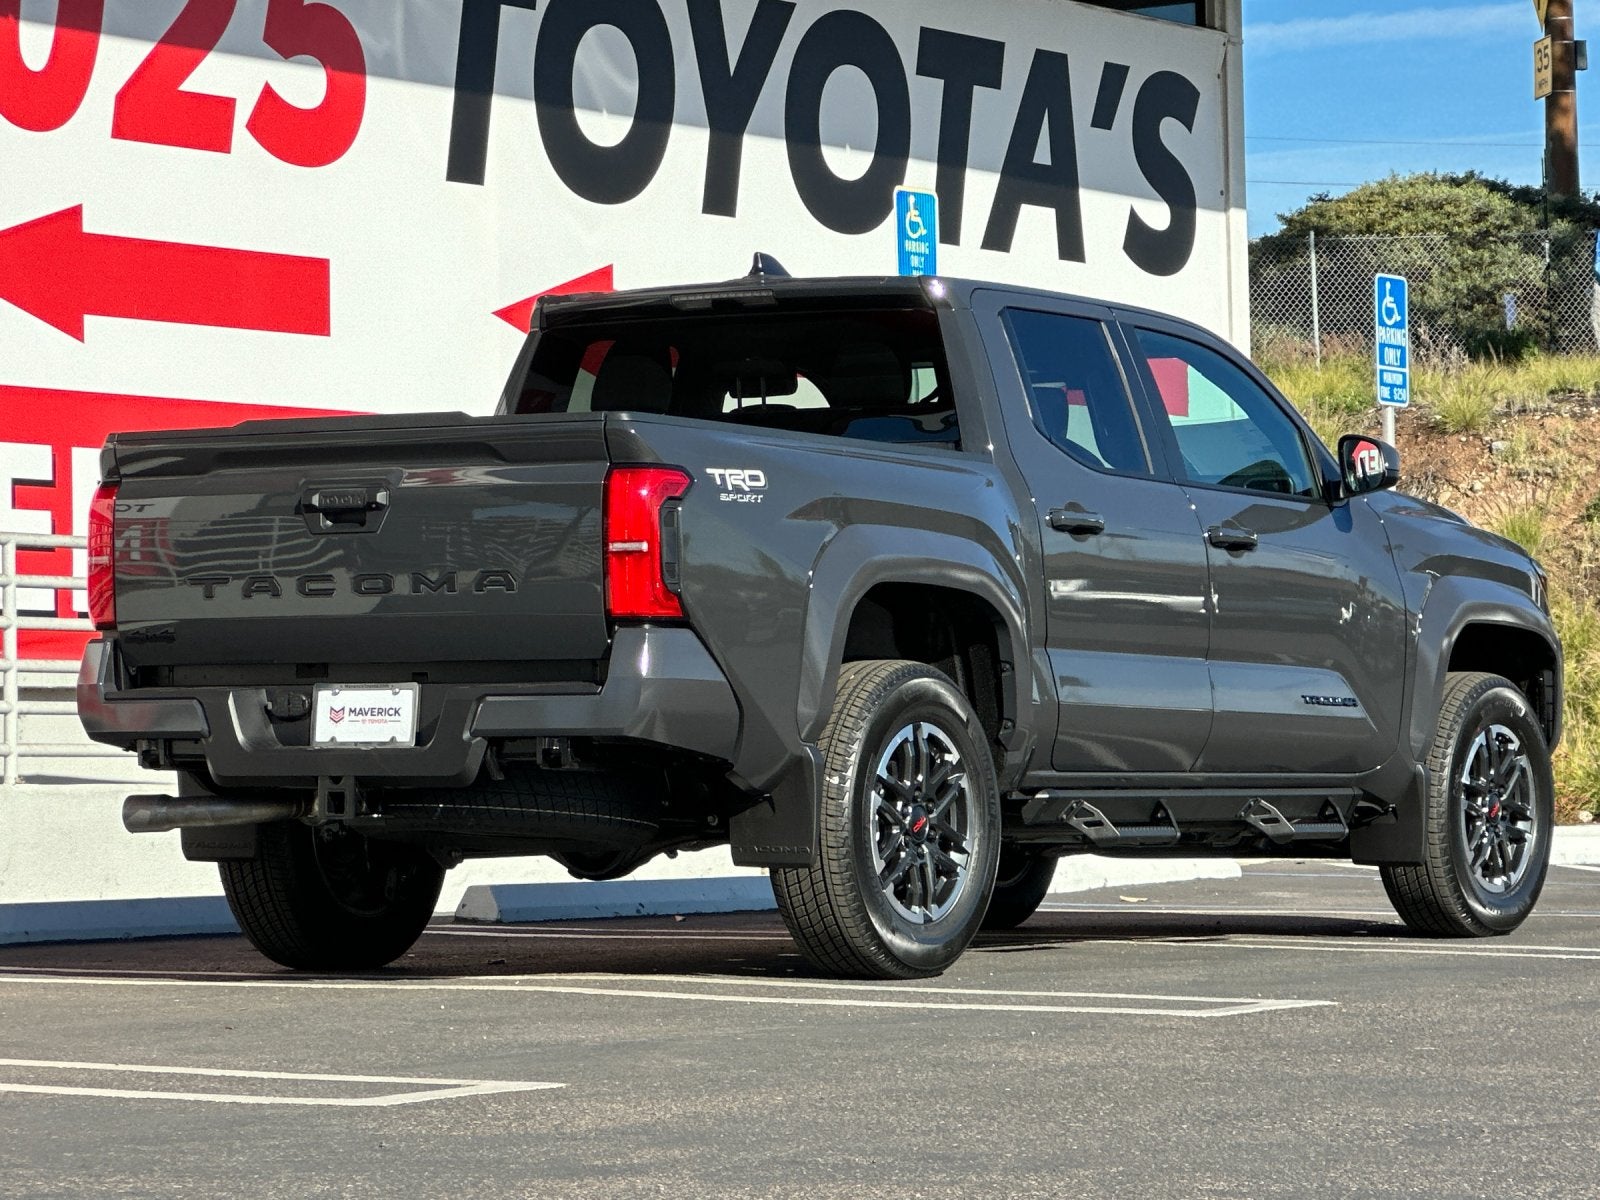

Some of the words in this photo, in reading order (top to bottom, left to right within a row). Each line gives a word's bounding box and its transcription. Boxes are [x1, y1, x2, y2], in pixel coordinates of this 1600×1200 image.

[1537, 44, 1550, 73] 35
[446, 0, 1200, 276] TOYOTA'S
[1379, 326, 1406, 347] PARKING
[1384, 346, 1401, 366] ONLY
[705, 467, 766, 492] TRD
[719, 493, 764, 503] SPORT
[188, 570, 517, 599] TACOMA
[348, 707, 401, 717] MAVERICK
